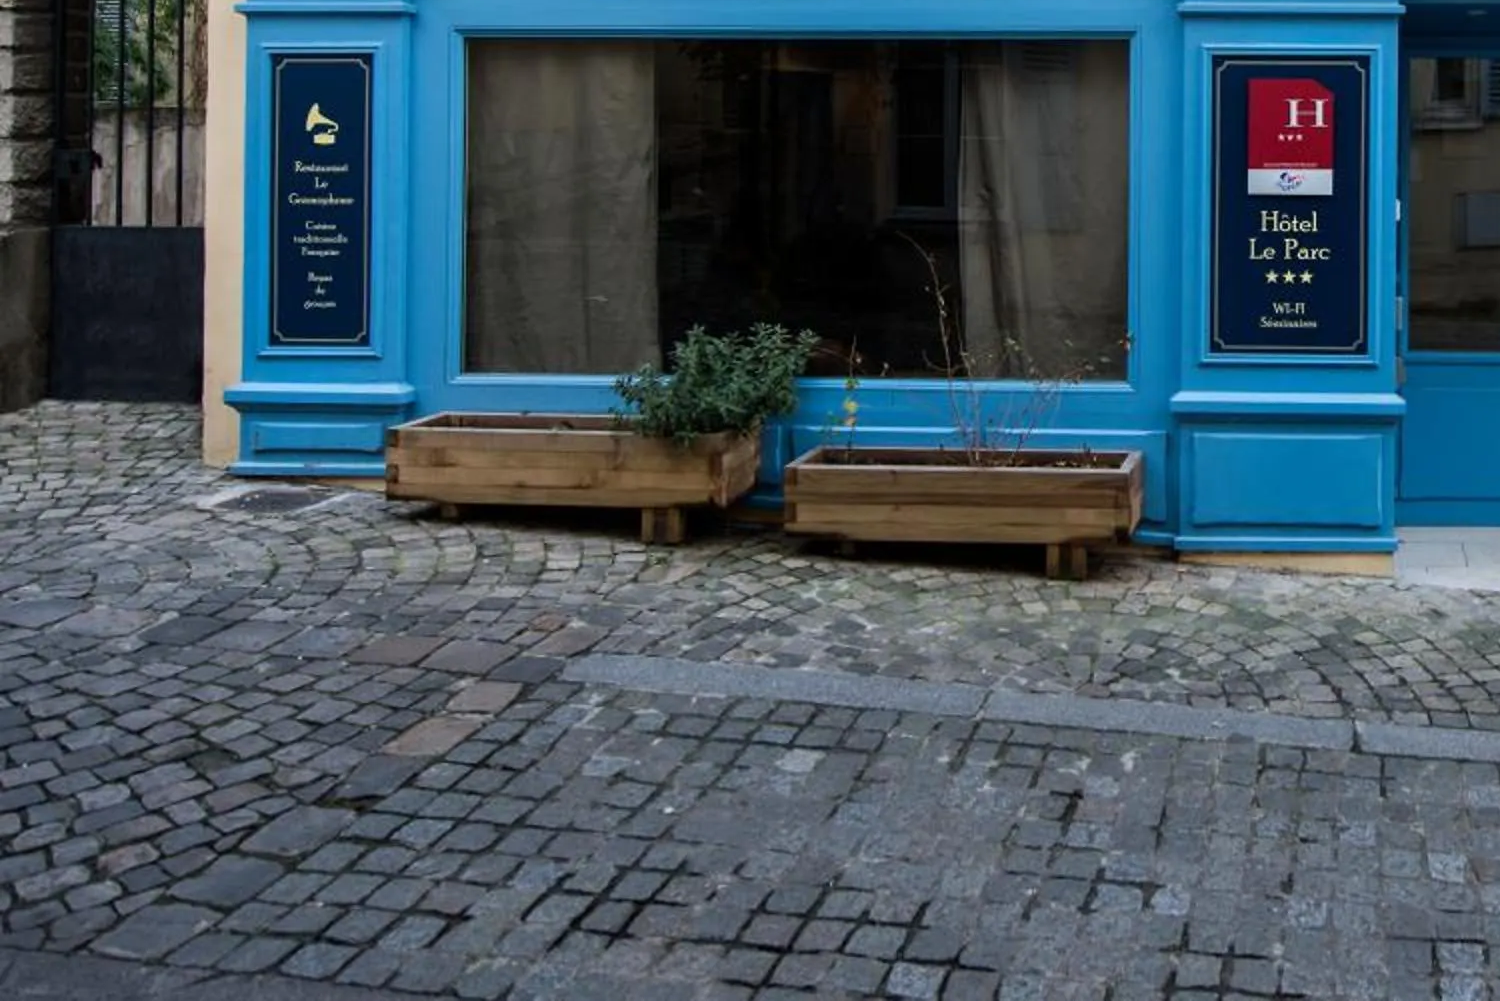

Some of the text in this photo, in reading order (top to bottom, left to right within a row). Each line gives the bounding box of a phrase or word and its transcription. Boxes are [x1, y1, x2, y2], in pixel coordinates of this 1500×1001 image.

[1285, 98, 1329, 128] H
[294, 160, 349, 173] Restaurant
[314, 176, 329, 189] Le
[287, 192, 355, 207] Gramophone
[1260, 210, 1318, 233] Hôtel
[1249, 238, 1331, 260] Le Parc
